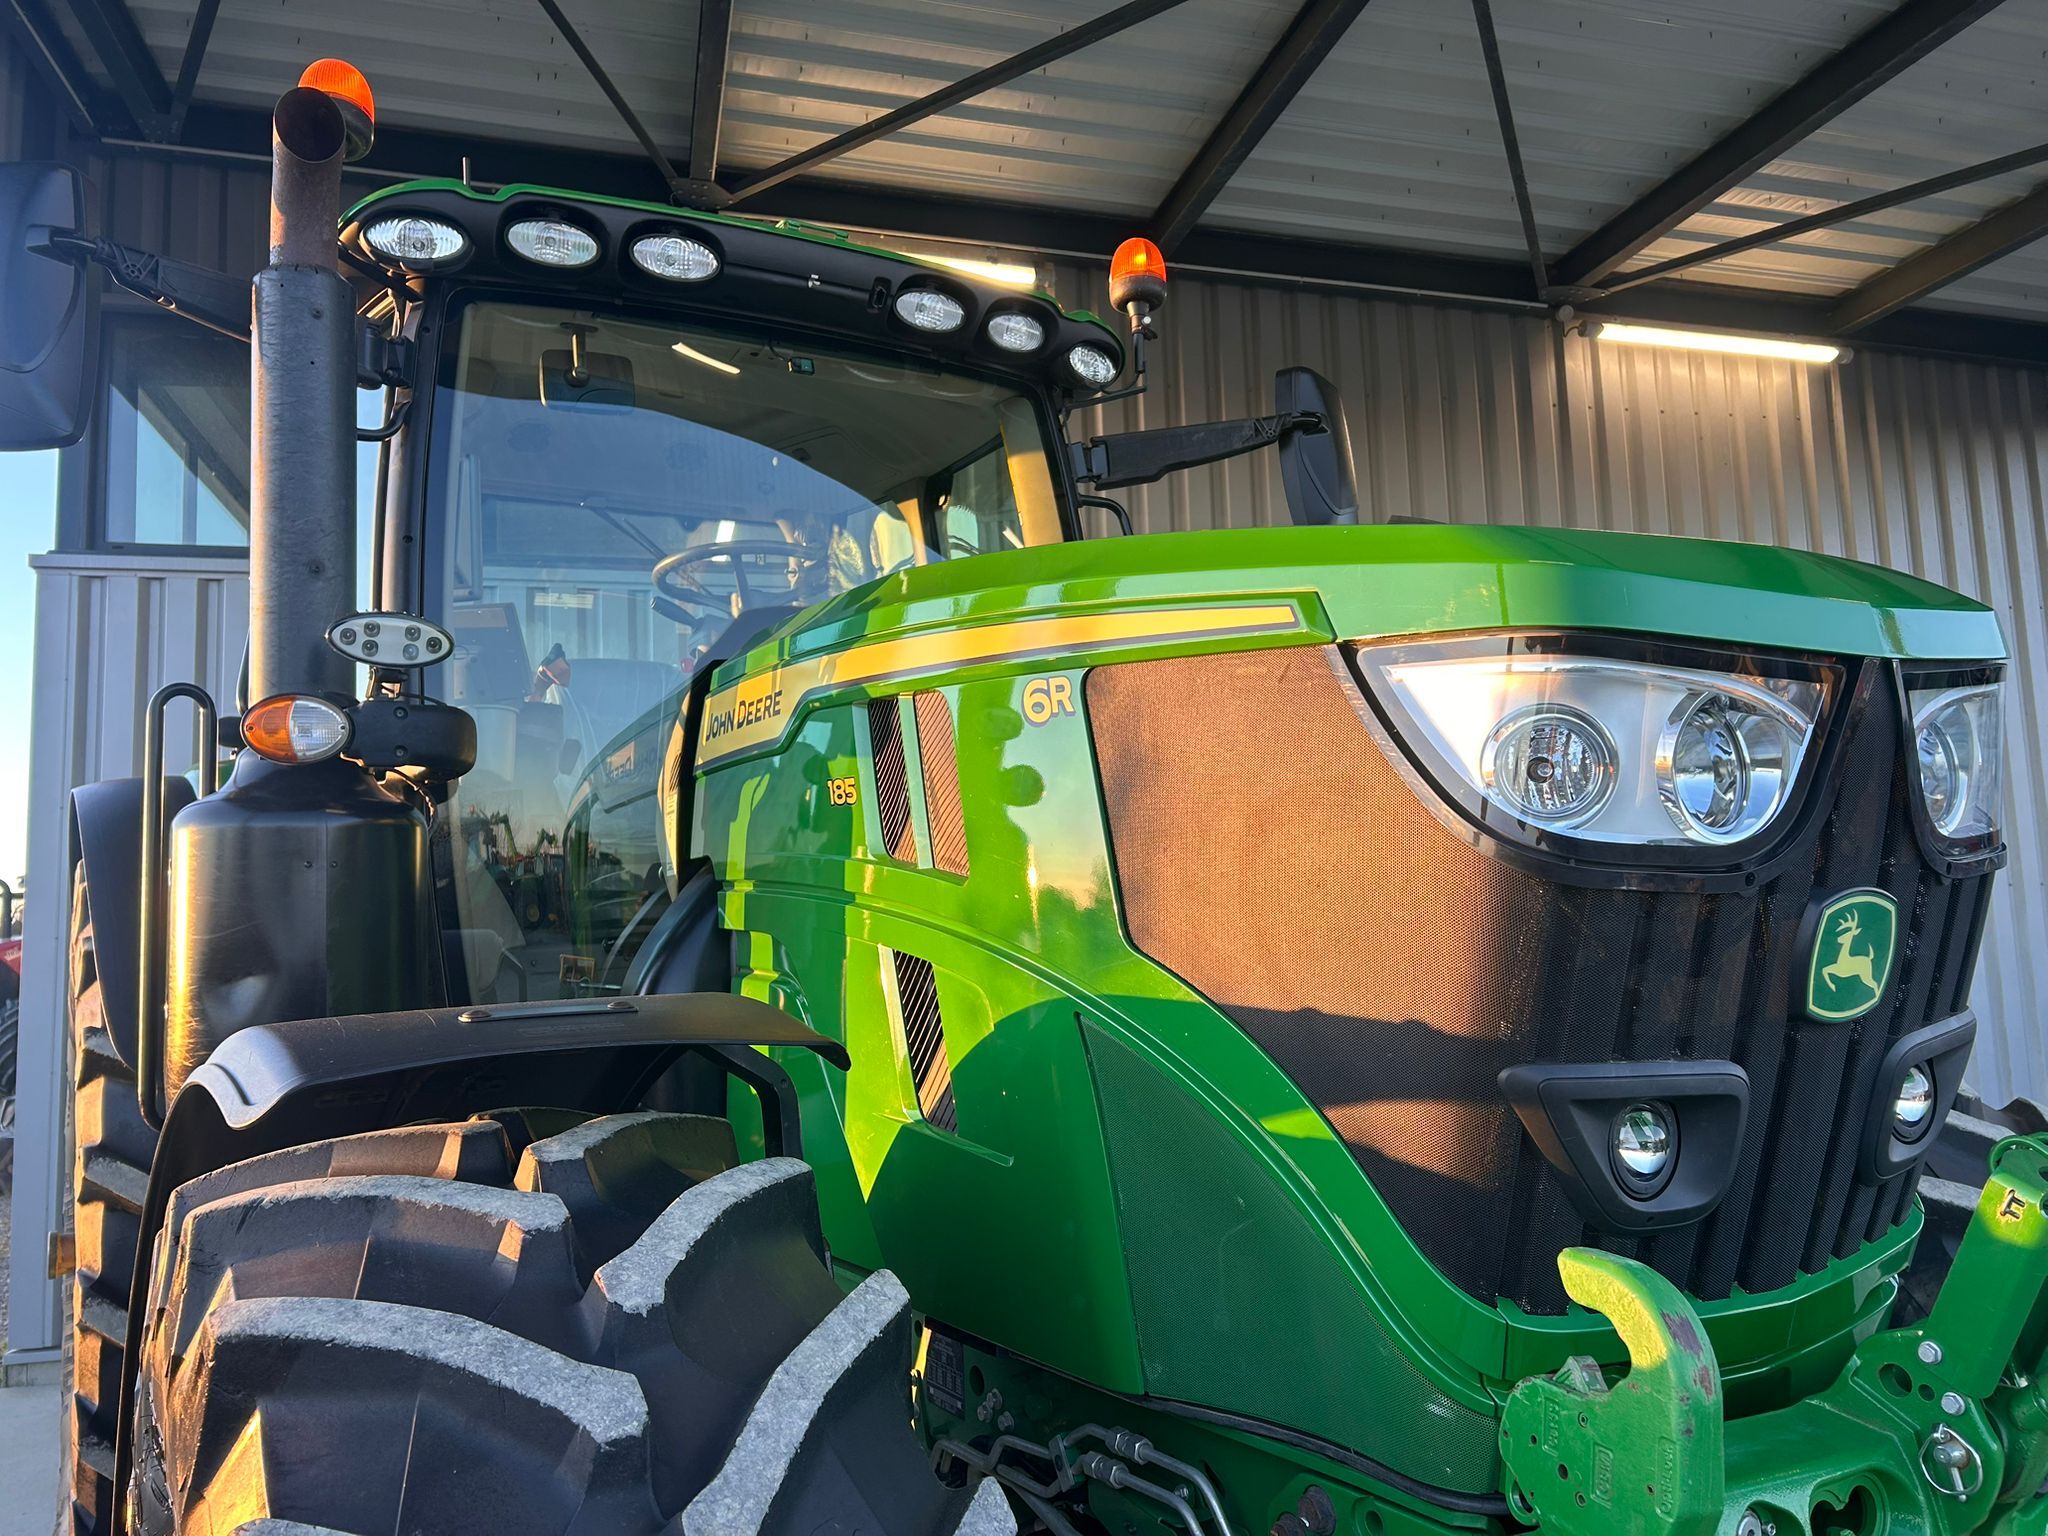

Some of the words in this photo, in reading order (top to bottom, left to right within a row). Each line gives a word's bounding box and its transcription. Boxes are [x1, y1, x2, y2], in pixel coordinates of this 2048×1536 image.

[706, 708, 735, 742] JOHN
[737, 690, 782, 729] DEERE
[1023, 676, 1075, 727] 6R
[827, 776, 857, 806] 185
